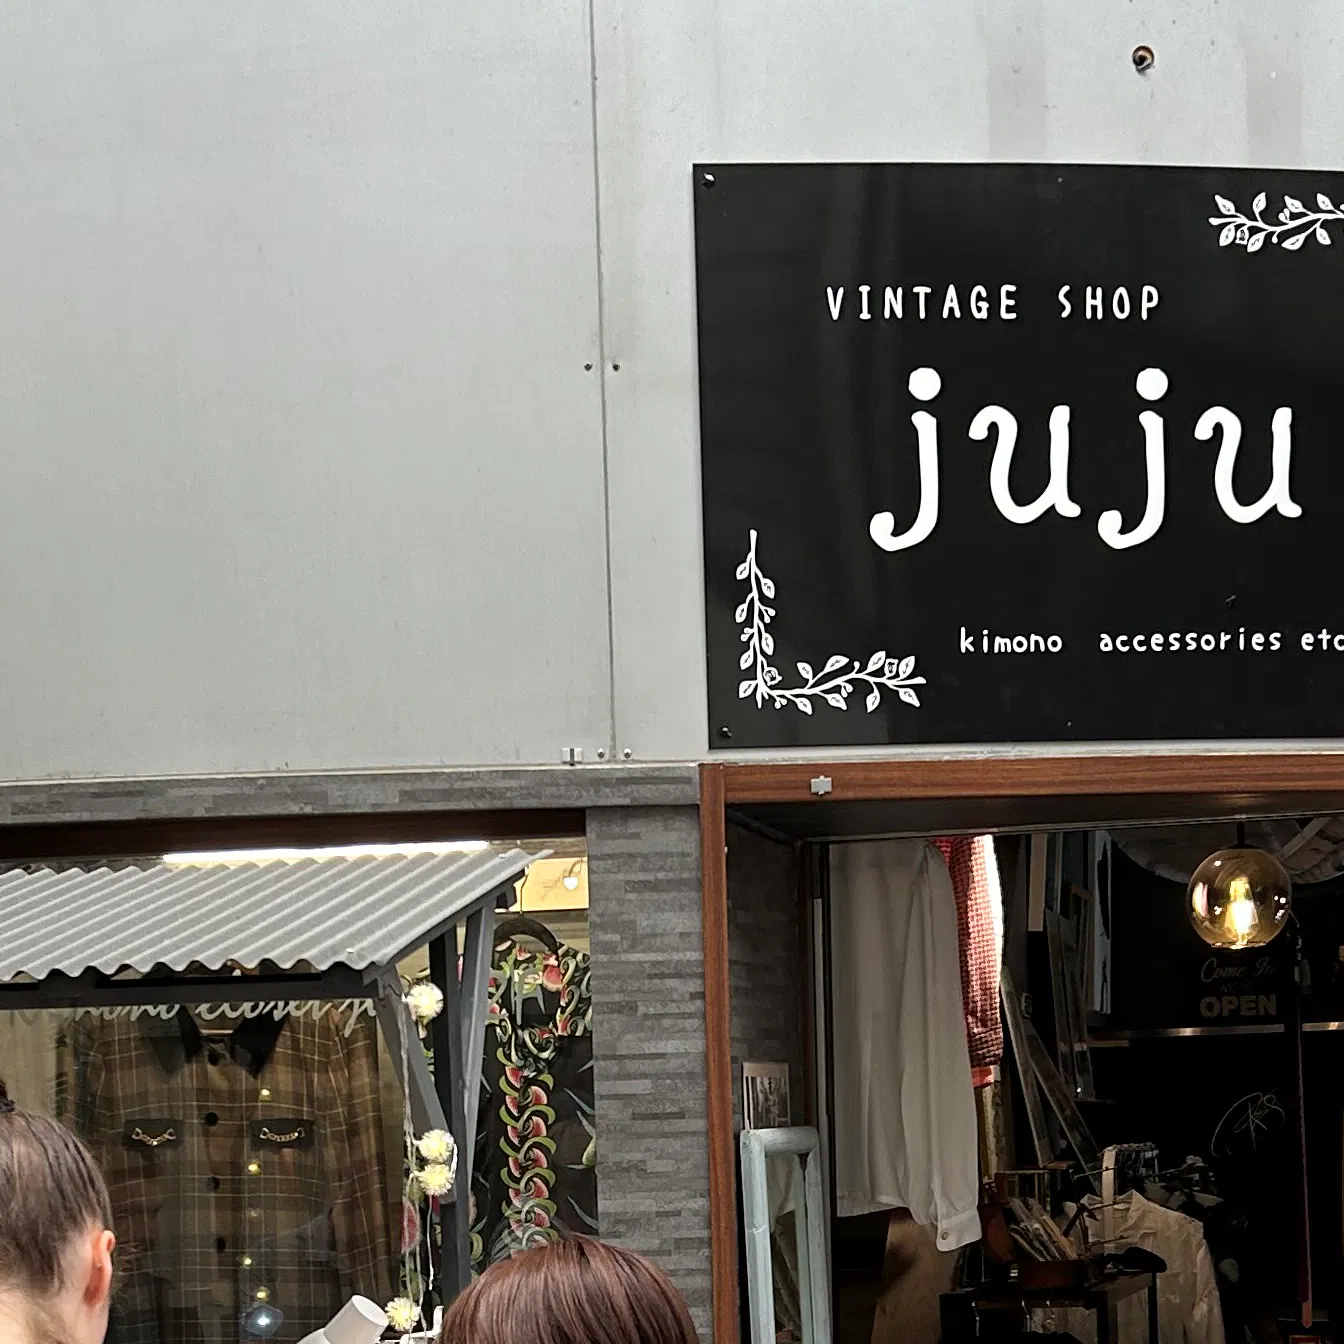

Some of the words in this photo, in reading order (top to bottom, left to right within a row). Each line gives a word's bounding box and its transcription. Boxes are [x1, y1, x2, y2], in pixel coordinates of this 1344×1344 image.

[826, 284, 1018, 321] VINTAGE
[1058, 284, 1160, 321] SHOP
[869, 367, 1303, 552] juju
[959, 626, 1064, 654] kimono
[1098, 627, 1282, 653] accessories
[1199, 993, 1278, 1019] OPEN
